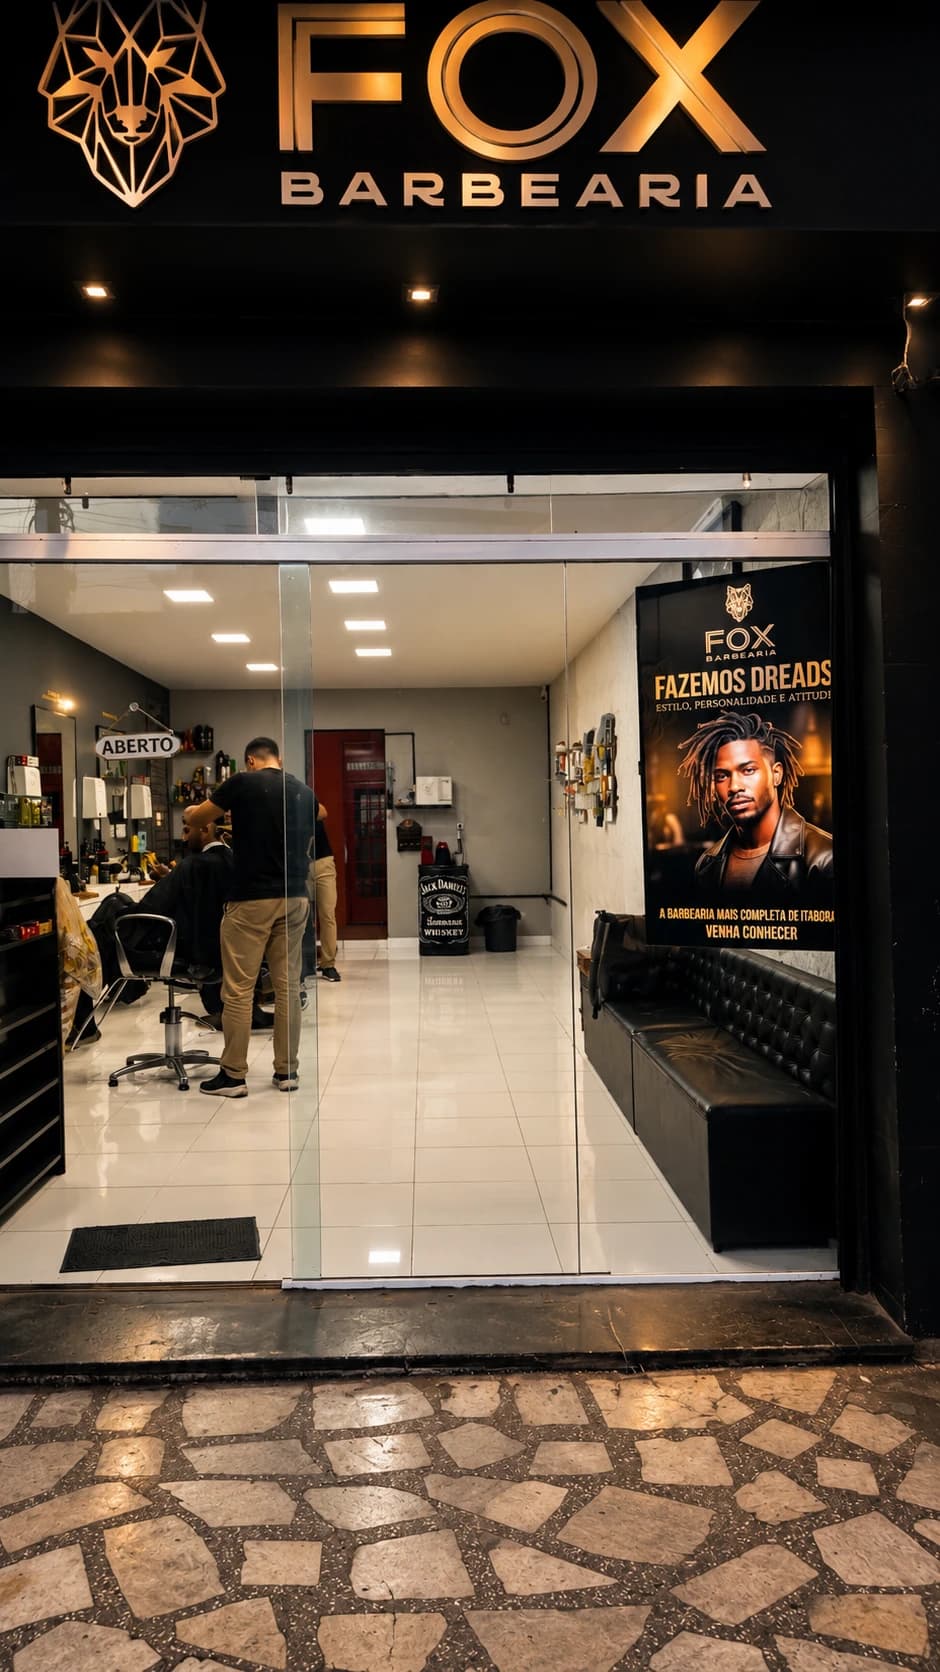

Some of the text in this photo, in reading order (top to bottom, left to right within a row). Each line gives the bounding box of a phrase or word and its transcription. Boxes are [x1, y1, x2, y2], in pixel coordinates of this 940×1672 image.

[277, 0, 767, 161] FOX
[281, 170, 773, 209] BARBEARIA
[705, 624, 776, 654] FOX
[705, 649, 777, 663] BARBEARIA
[654, 659, 832, 700] FAZEMOS DREADS
[655, 701, 692, 713] ESTILO,
[694, 694, 777, 711] PERSONALIDADE
[779, 693, 786, 703] E
[102, 737, 174, 755] ABERTO
[659, 907, 666, 920] A
[667, 907, 715, 921] BARBEARIA
[716, 908, 738, 921] MAIS
[740, 908, 787, 922] COMPLETA
[788, 909, 799, 922] DE
[424, 928, 464, 937] WHISKEY
[705, 924, 798, 941] VENHA CONHECER
